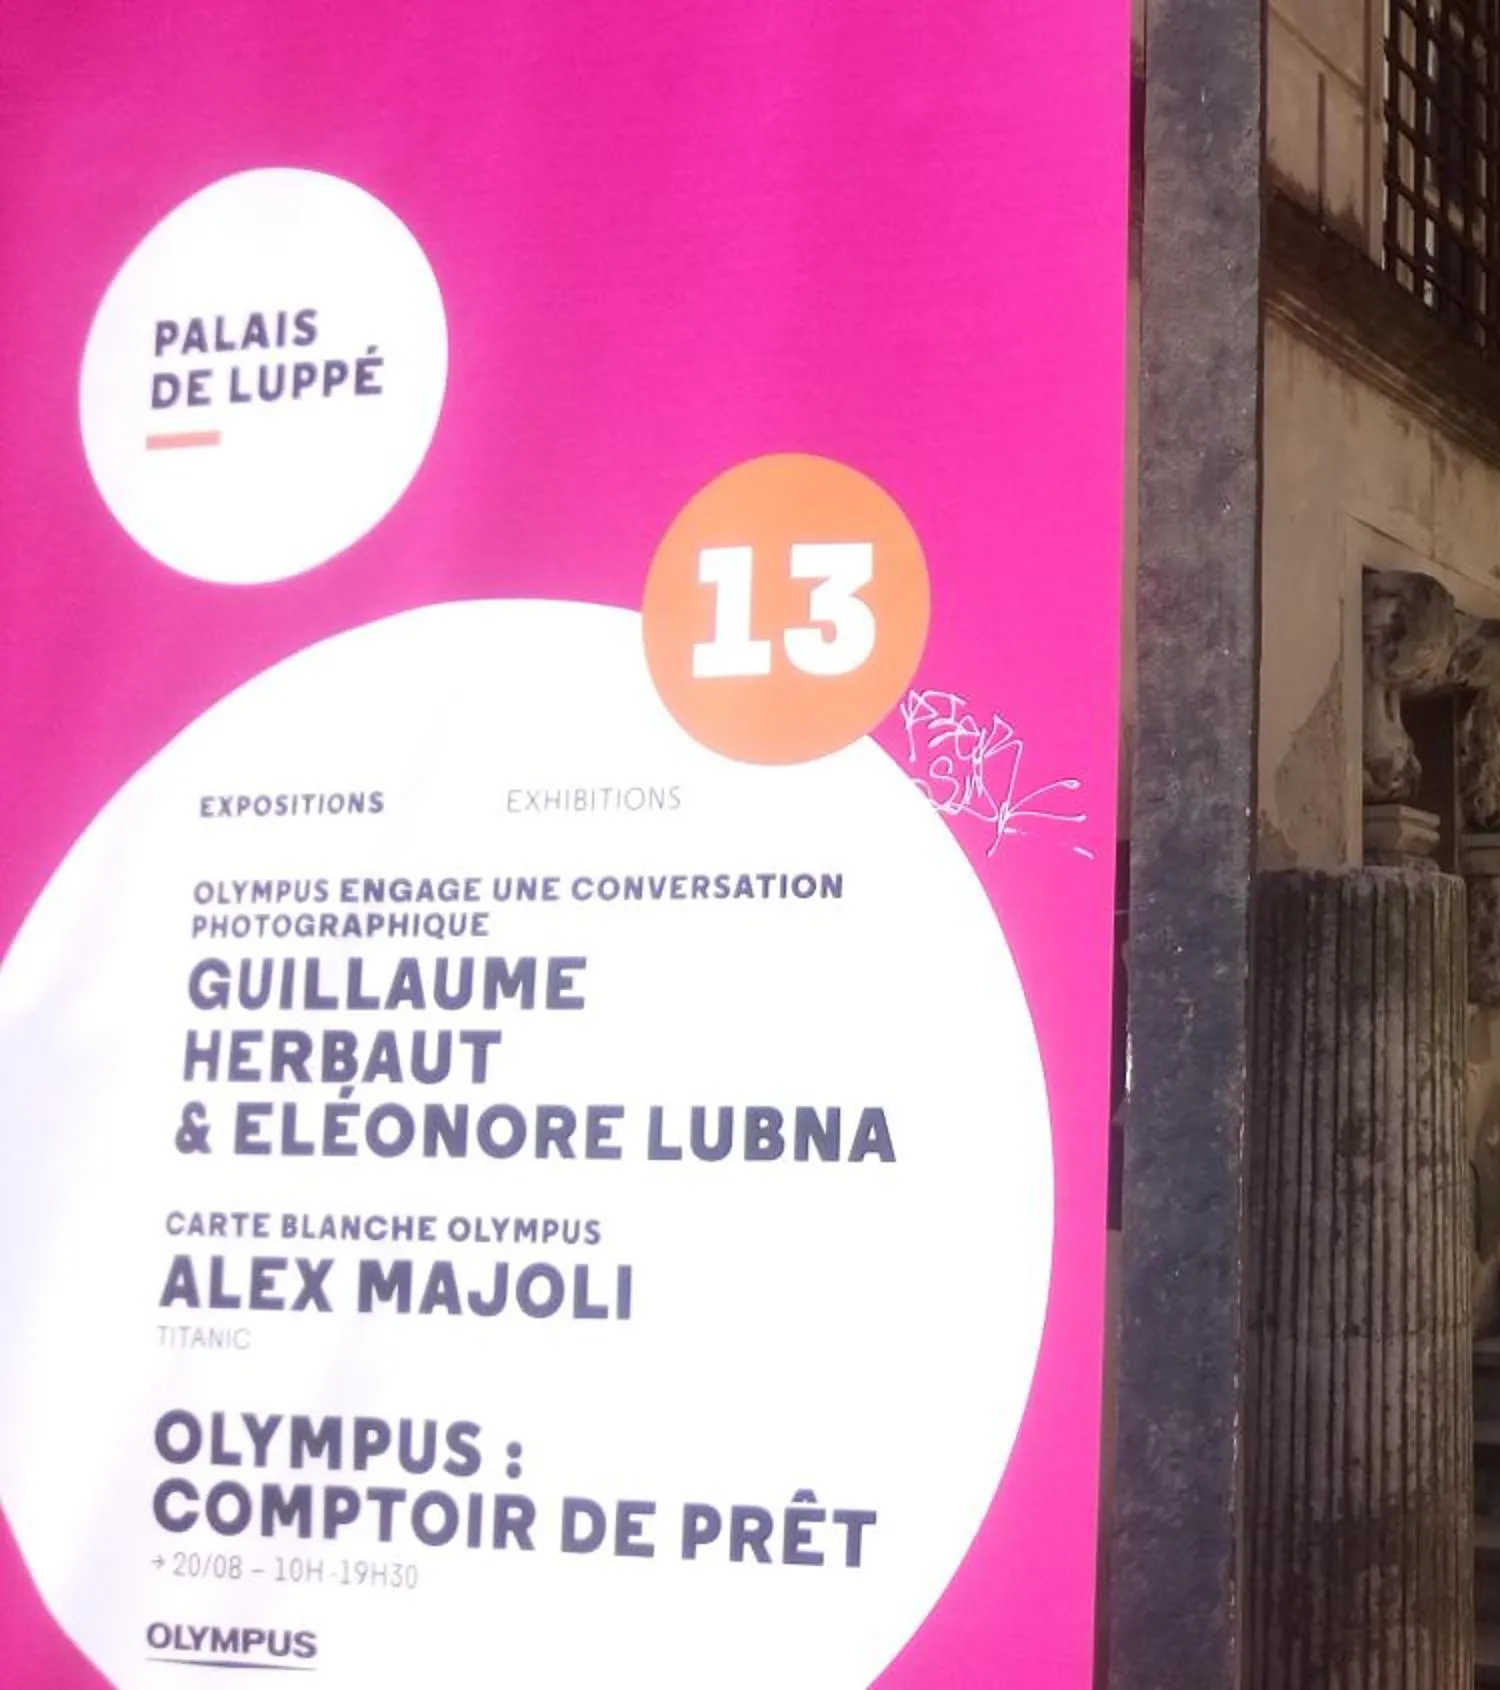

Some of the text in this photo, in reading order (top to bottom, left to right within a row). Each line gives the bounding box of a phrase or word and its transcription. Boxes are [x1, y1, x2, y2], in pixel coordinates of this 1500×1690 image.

[154, 308, 318, 355] PALAIS
[151, 344, 384, 410] DE LUPPÉ
[692, 541, 876, 679] 13
[200, 791, 384, 818] EXPOSITIONS
[507, 786, 680, 813] EXHIBITIONS
[193, 873, 843, 905] OLYMPUS ENGAGE UNE CONVERSATION
[192, 912, 489, 940] PHOTOGRAPHIQUE
[188, 956, 587, 1011] GUILLAUME
[183, 1029, 502, 1085] HERBAUT
[174, 1085, 896, 1163] & ELÉONORE LUBNA
[166, 1210, 601, 1246] CARTE BLANCHE OLYMPUS
[158, 1254, 632, 1320] ALEX MAJOLI
[157, 1325, 250, 1350] TITANIC
[153, 1408, 482, 1477] OLYMPUS
[152, 1477, 877, 1568] COMPTOIR DE PRÊT
[173, 1552, 243, 1581] 20/08
[146, 1622, 317, 1659] OLYMPUS
